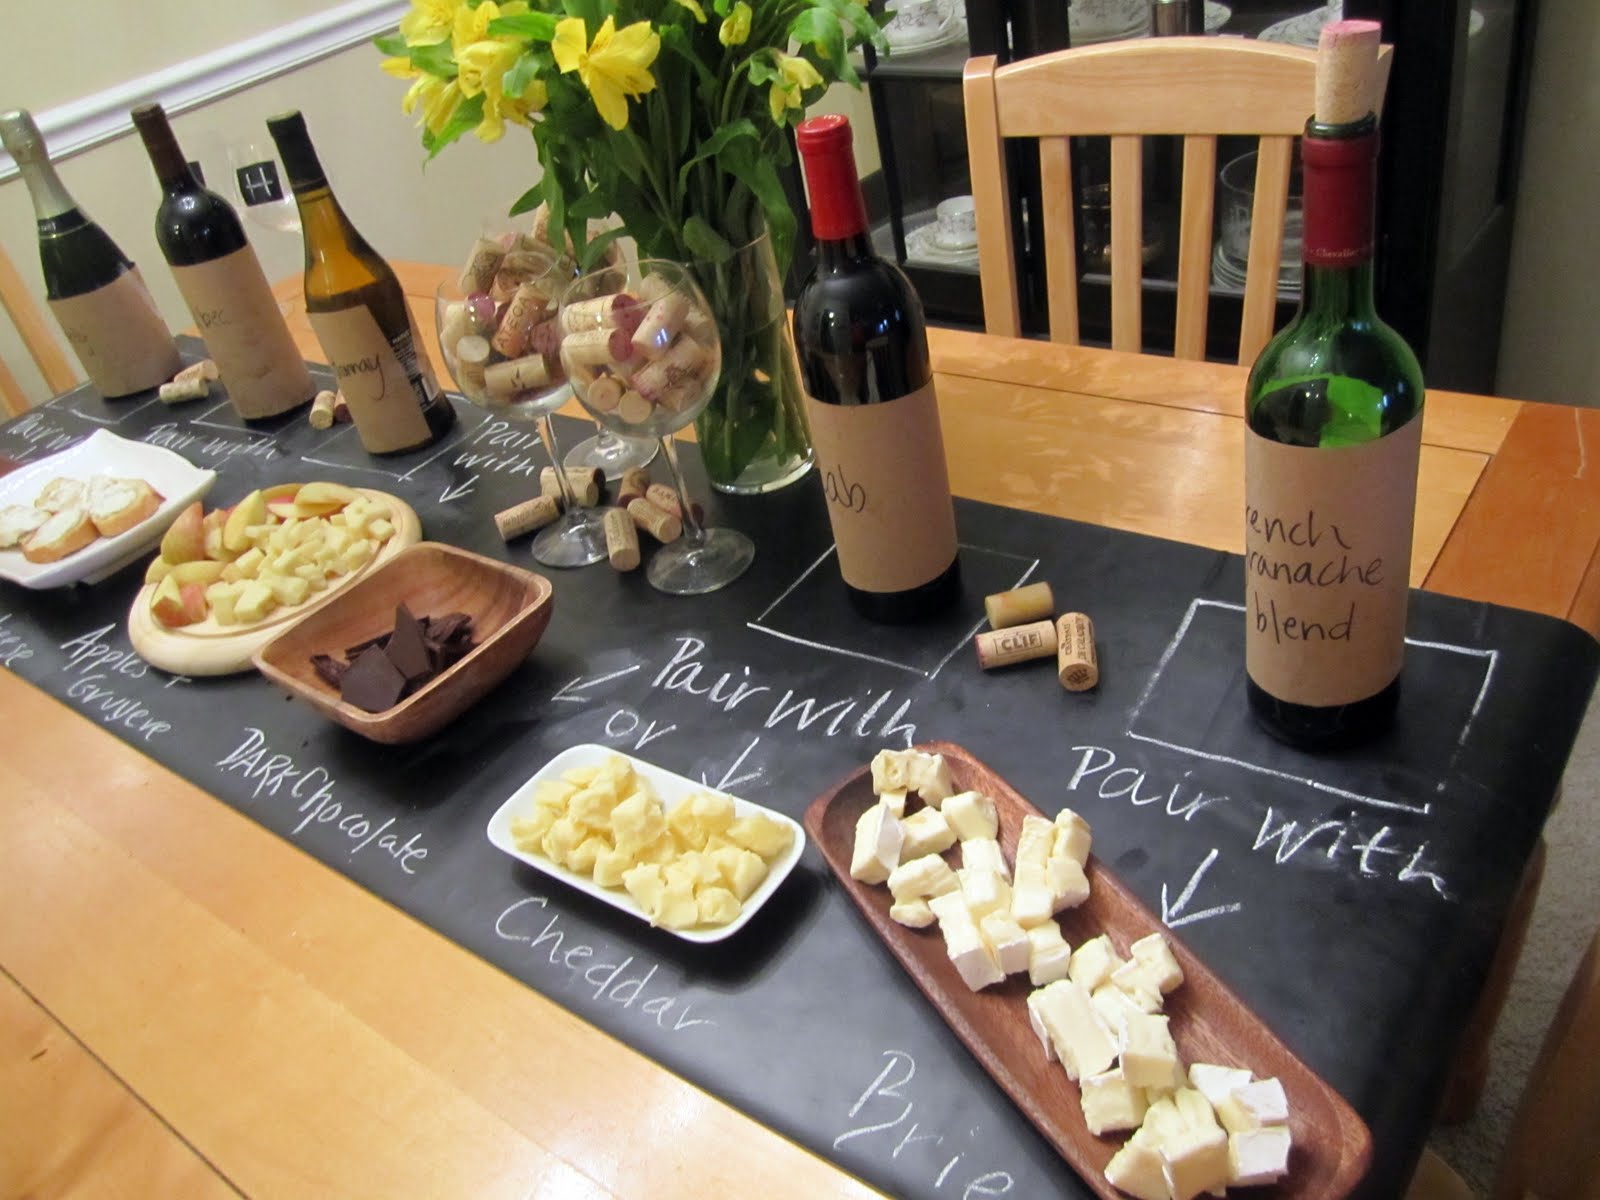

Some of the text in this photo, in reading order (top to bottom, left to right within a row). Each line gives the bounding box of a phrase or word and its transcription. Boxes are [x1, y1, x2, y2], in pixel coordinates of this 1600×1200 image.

[245, 166, 274, 201] H
[145, 421, 278, 461] Pair with
[472, 421, 546, 450] Pair
[453, 450, 535, 477] with
[1001, 632, 1039, 651] CLIF
[1254, 591, 1356, 645] blend
[59, 622, 151, 679] Apples
[651, 636, 917, 748] Pair with
[215, 726, 430, 875] DARK Chocolate
[1066, 745, 1231, 821] Pair
[494, 896, 718, 1031] Cheddar
[832, 1049, 1015, 1200] Brie
